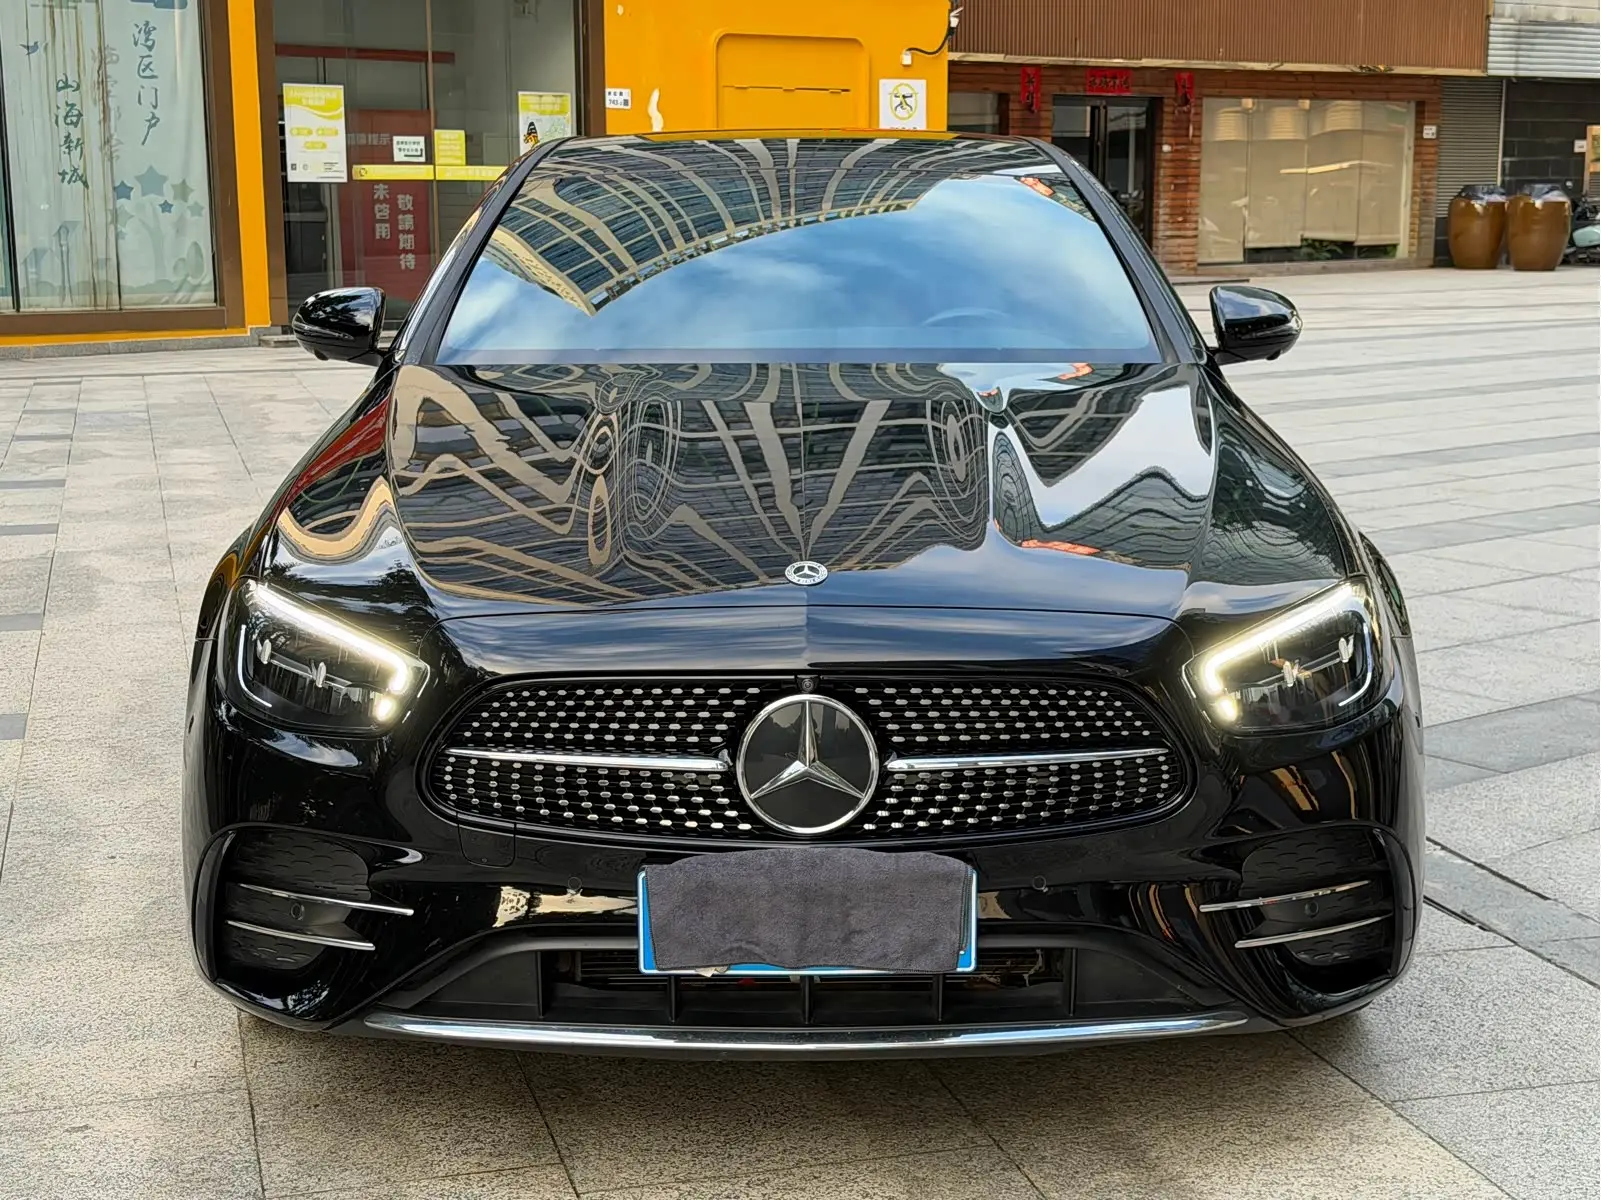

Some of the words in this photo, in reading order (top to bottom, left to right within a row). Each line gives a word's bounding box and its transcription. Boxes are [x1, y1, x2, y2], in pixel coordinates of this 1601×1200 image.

[54, 73, 89, 190] 山海新城
[132, 20, 160, 146] 湾区门户
